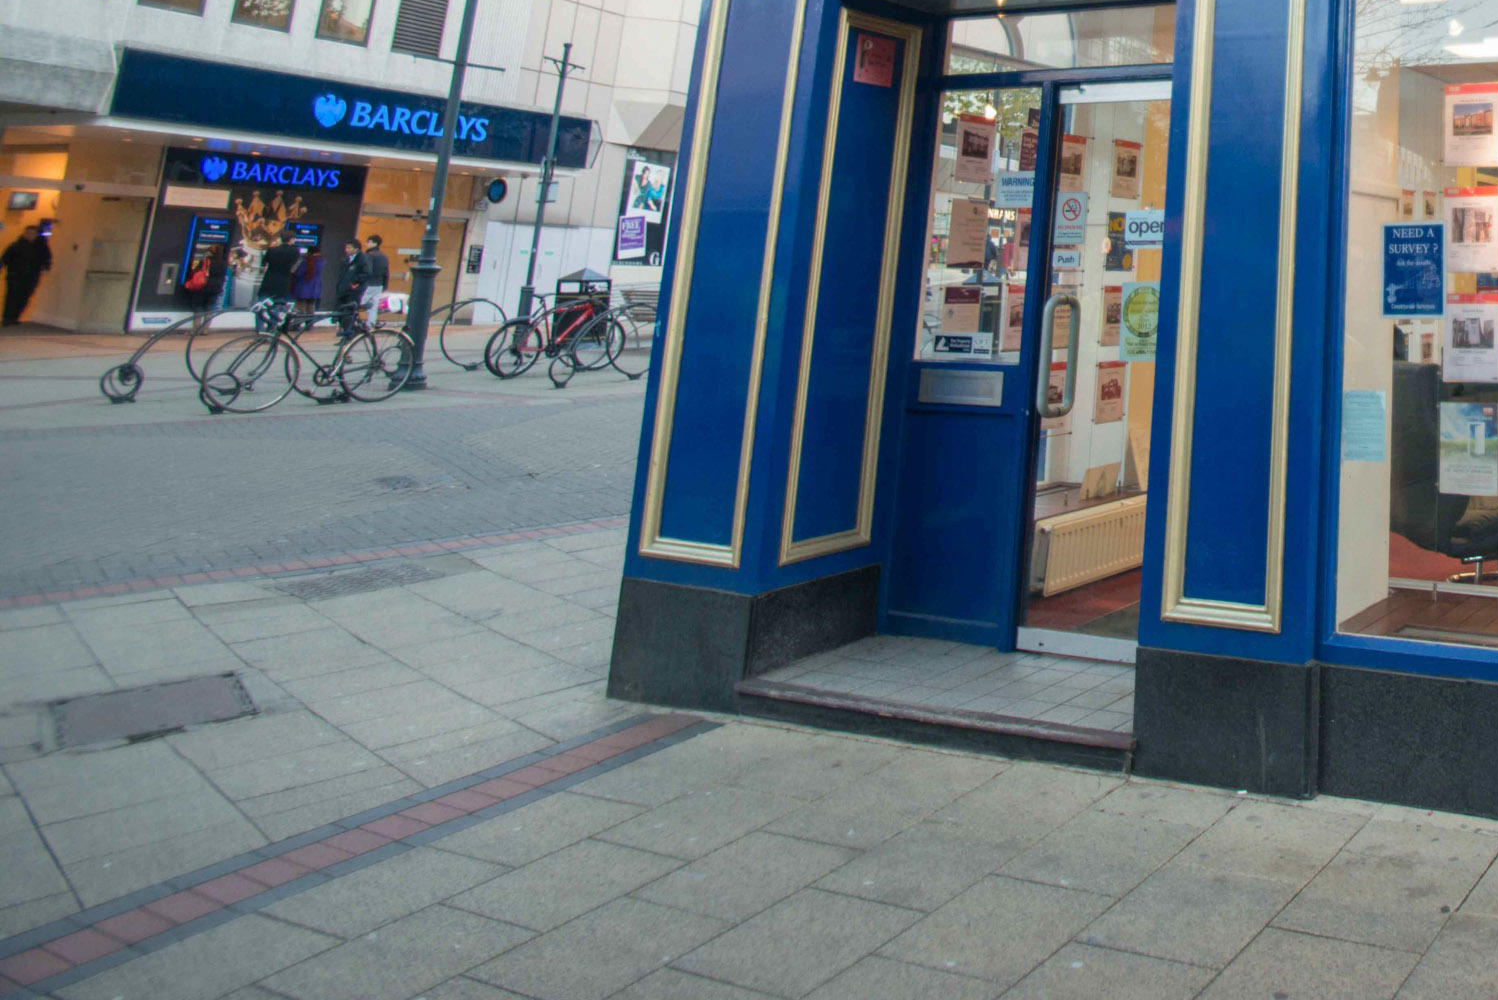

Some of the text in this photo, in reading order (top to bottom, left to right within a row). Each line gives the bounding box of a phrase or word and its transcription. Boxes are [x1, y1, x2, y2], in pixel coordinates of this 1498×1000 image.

[350, 101, 490, 143] BARCLYS
[230, 160, 341, 189] BARCLAYS
[1109, 216, 1125, 231] NO
[1392, 227, 1434, 239] NEED A
[1388, 243, 1430, 255] SURVEY
[1057, 255, 1075, 264] Push
